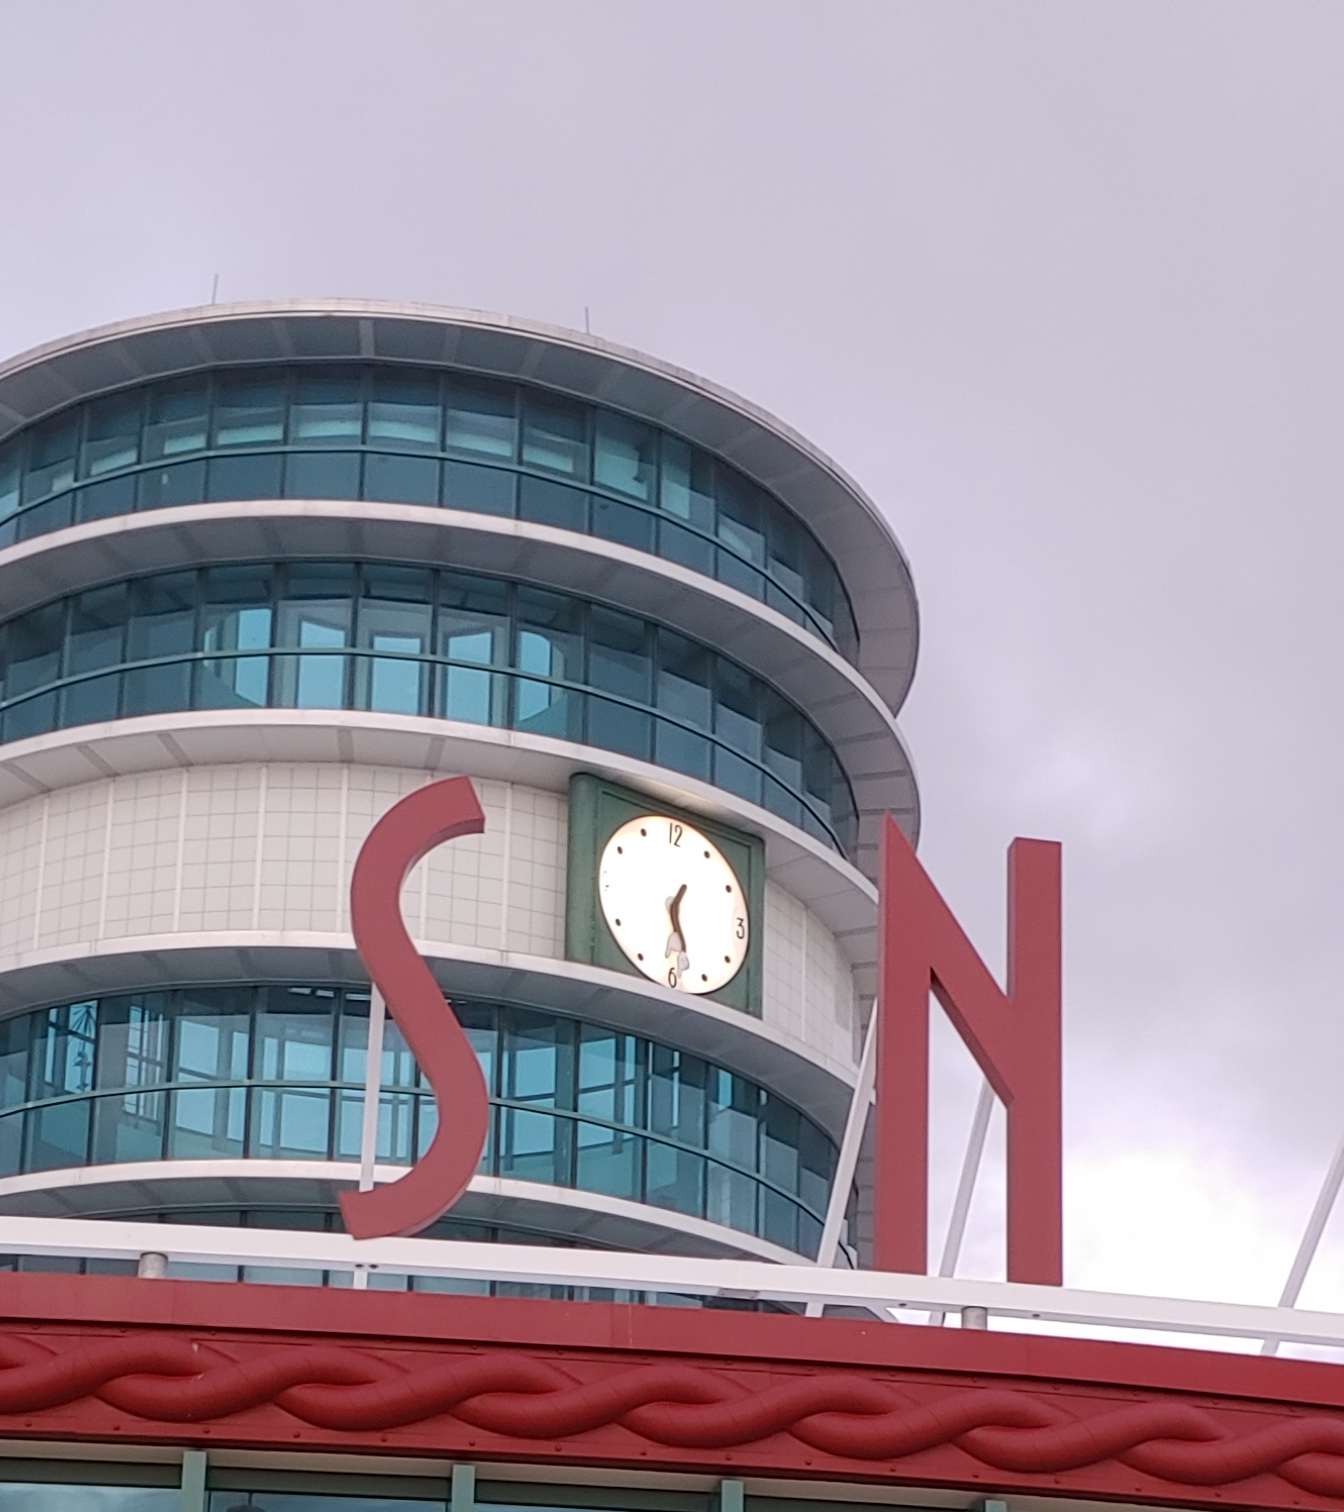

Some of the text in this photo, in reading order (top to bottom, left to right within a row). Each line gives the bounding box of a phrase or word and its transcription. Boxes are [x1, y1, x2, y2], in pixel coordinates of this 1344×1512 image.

[668, 822, 683, 847] 12
[736, 917, 745, 940] 3
[668, 967, 677, 988] 6
